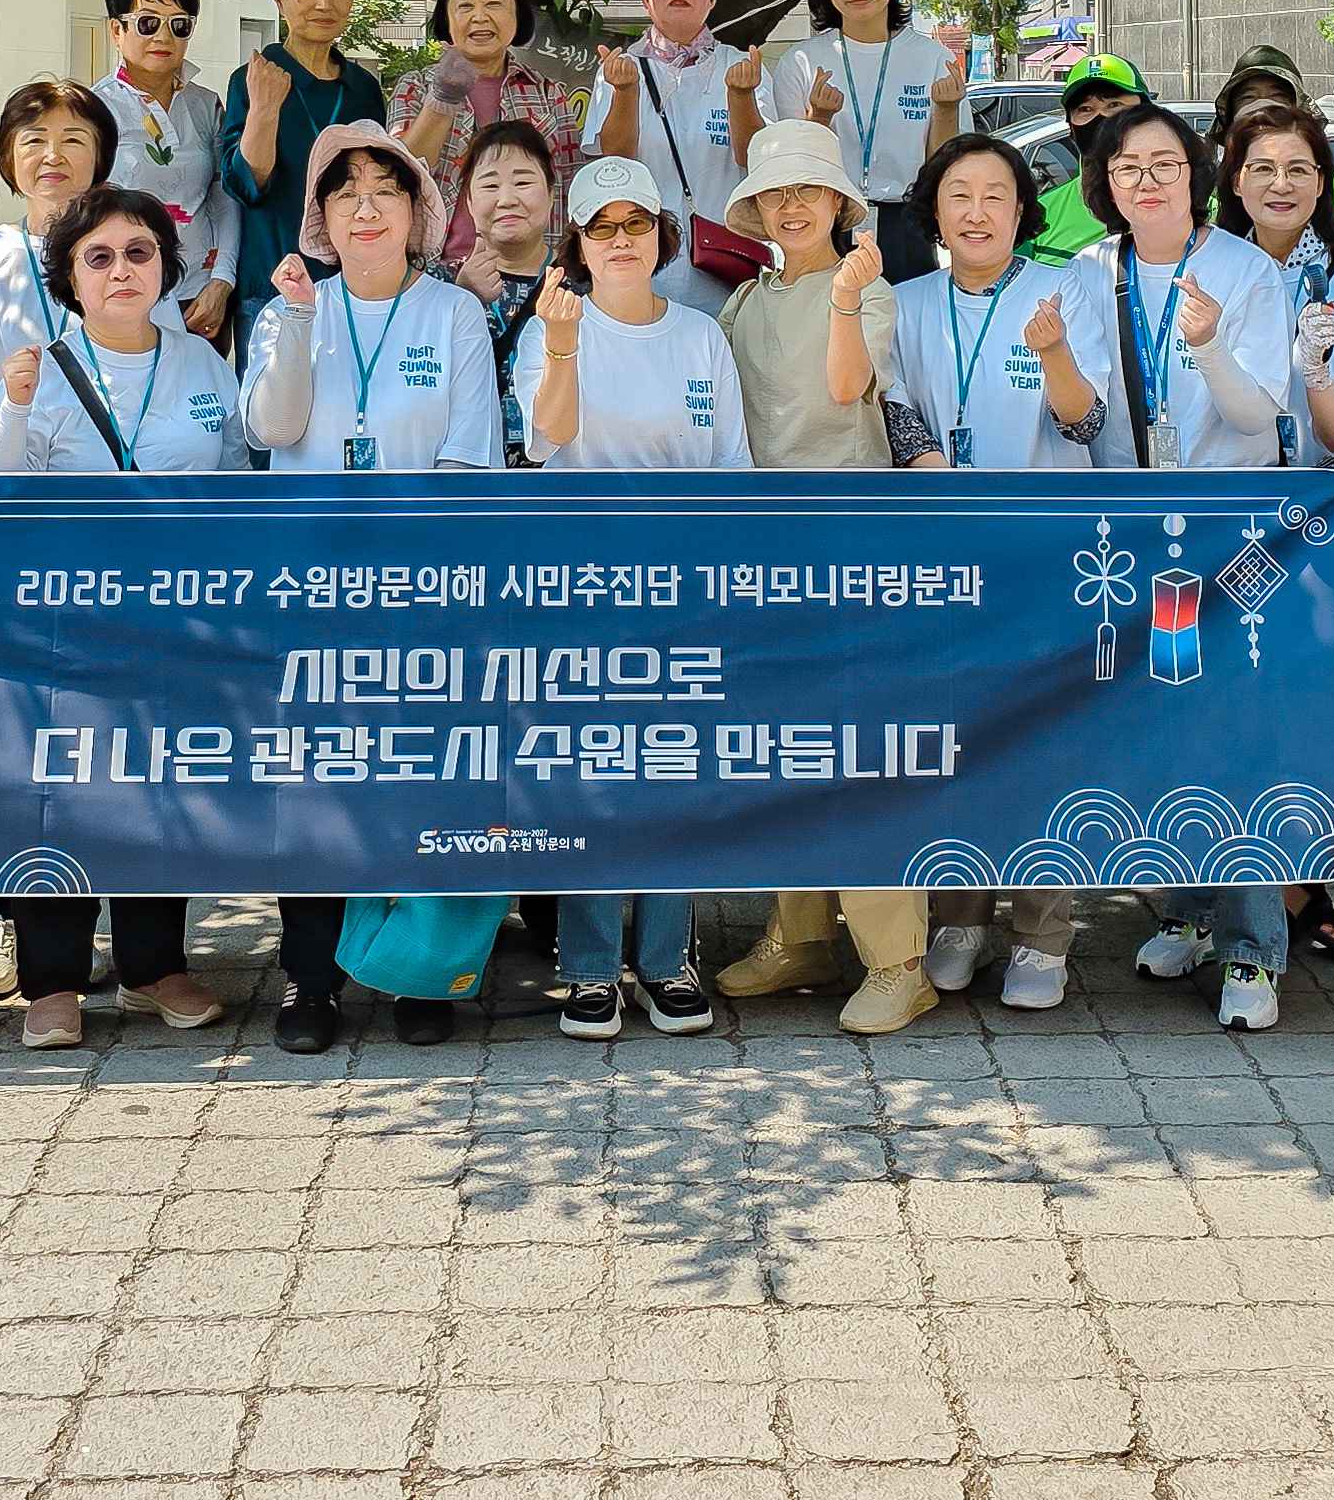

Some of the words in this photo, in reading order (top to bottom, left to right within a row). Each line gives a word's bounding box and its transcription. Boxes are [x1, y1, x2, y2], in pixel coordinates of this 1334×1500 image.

[903, 85, 926, 97] VISIT
[898, 96, 931, 109] SUWON
[903, 109, 928, 121] YEAR
[704, 120, 729, 134] SUW
[709, 133, 730, 147] YEA
[406, 346, 436, 360] VISIT
[398, 359, 443, 375] SUWON
[404, 374, 438, 388] YEAR
[1009, 376, 1042, 390] YEAR
[188, 392, 220, 407] VISIT
[685, 394, 714, 410] SUWO
[189, 406, 225, 421] SUWO
[17, 568, 254, 607] 2026-2027
[267, 565, 487, 609] 수원방문의해
[500, 564, 682, 607] 시민추진단
[695, 563, 984, 607] 기획모니터링분과
[278, 646, 464, 705] 시민의
[480, 645, 727, 703] 시선으로
[33, 726, 95, 785] 더
[110, 725, 234, 784] 나은
[248, 725, 499, 784] 관광도시
[514, 722, 700, 782] 수원을
[714, 722, 962, 780] 만듭니다
[510, 828, 548, 838] 2026-2027
[509, 837, 533, 852] 수원
[535, 837, 570, 852] 방문의
[573, 836, 586, 851] 해
